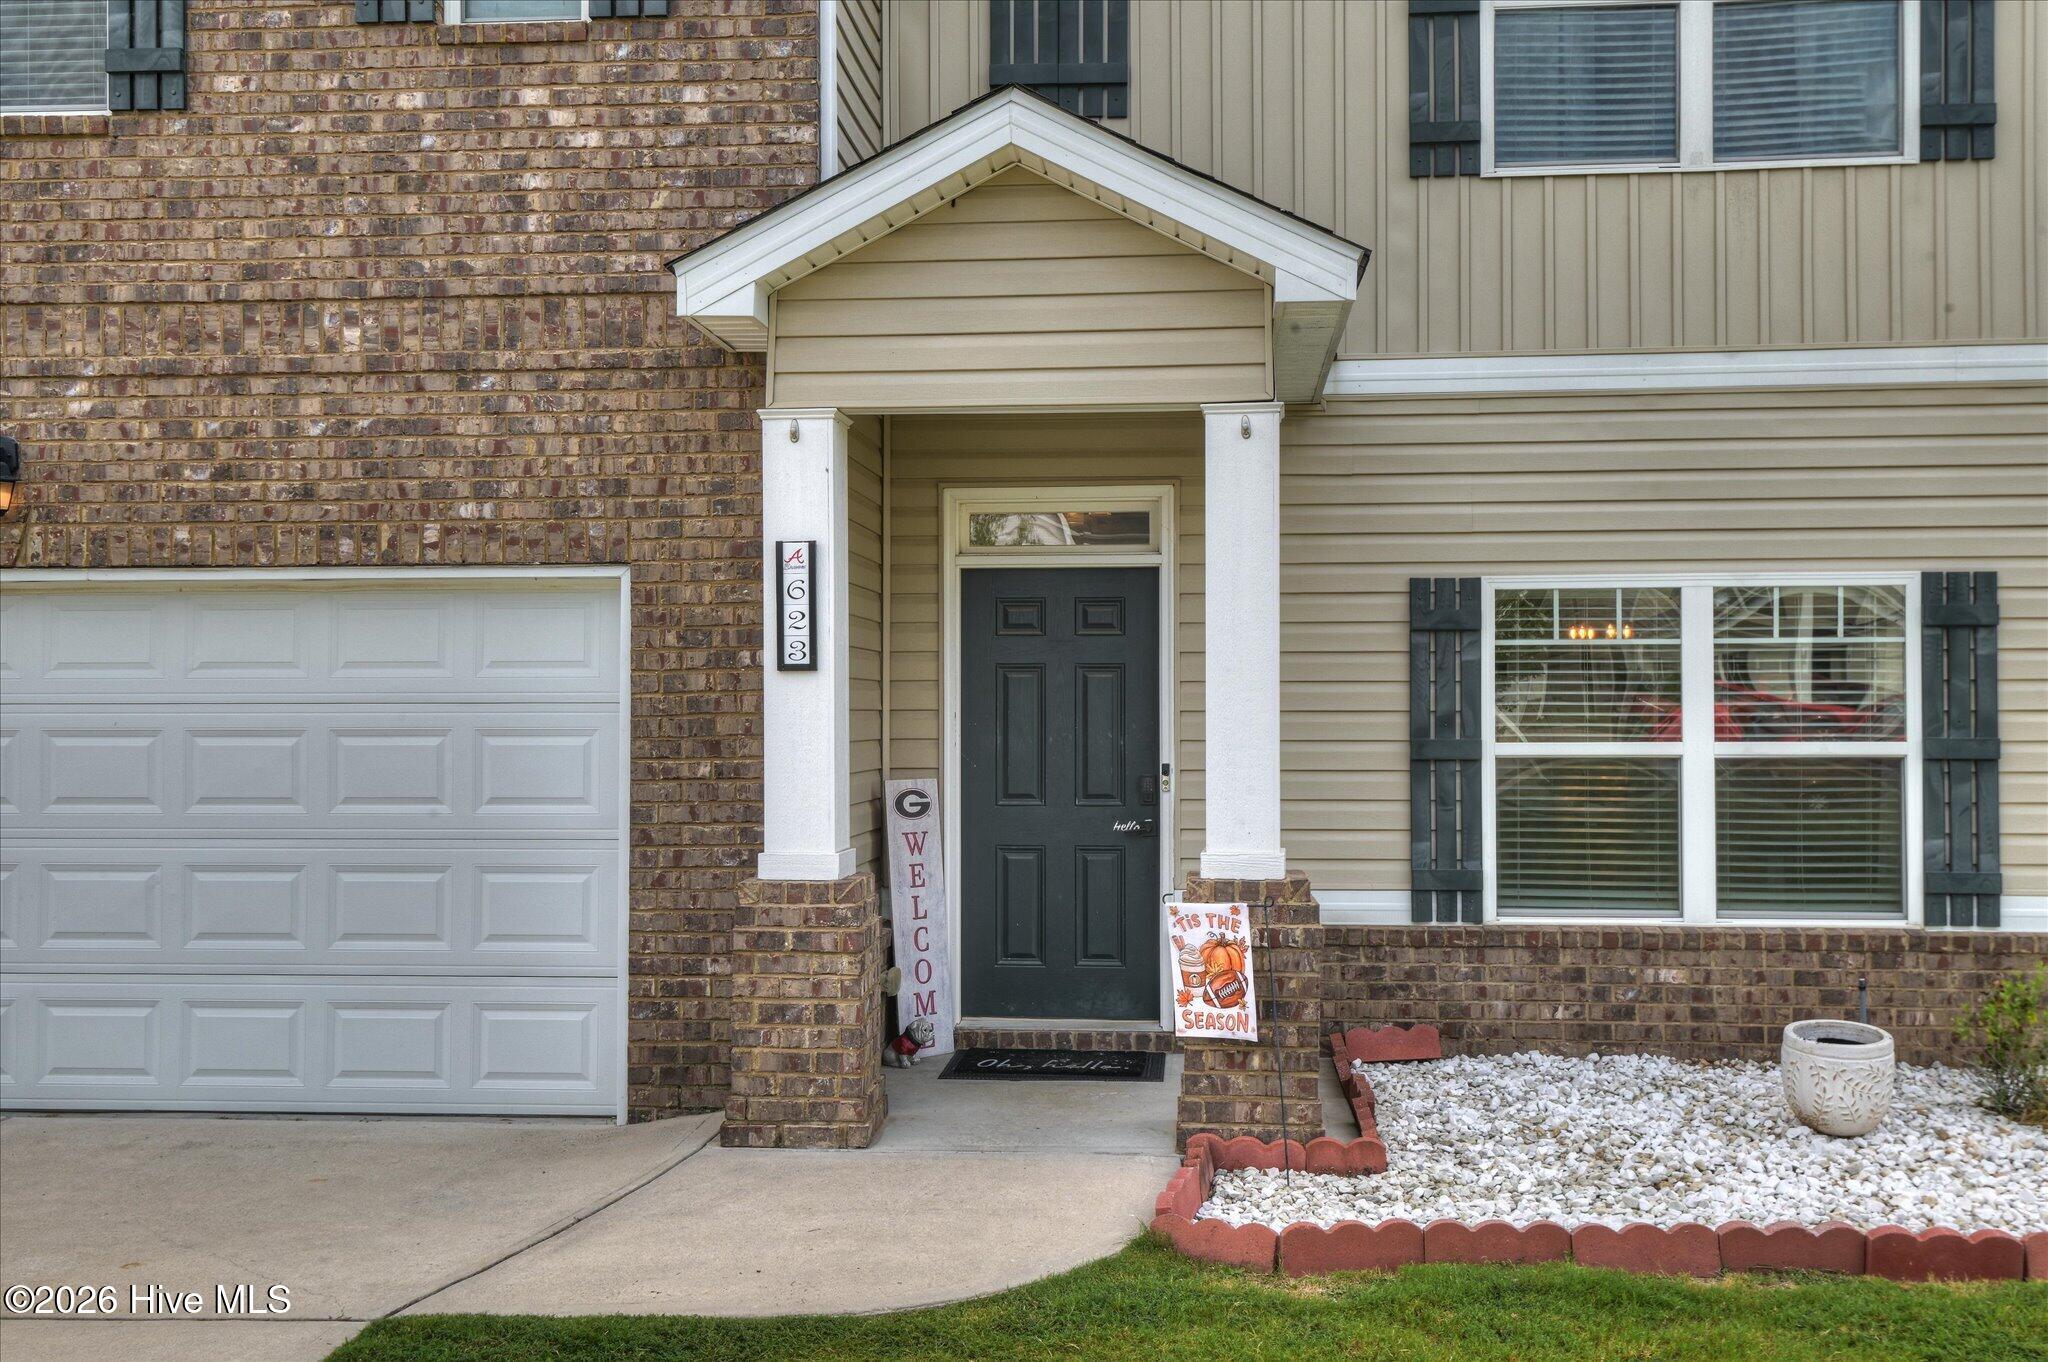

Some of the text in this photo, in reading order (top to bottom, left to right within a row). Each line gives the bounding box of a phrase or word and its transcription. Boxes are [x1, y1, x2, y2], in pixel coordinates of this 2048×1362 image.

[784, 547, 805, 564] A
[787, 579, 807, 661] 623
[895, 788, 932, 819] G
[1205, 912, 1242, 934] THE
[1181, 1009, 1249, 1034] SEASON
